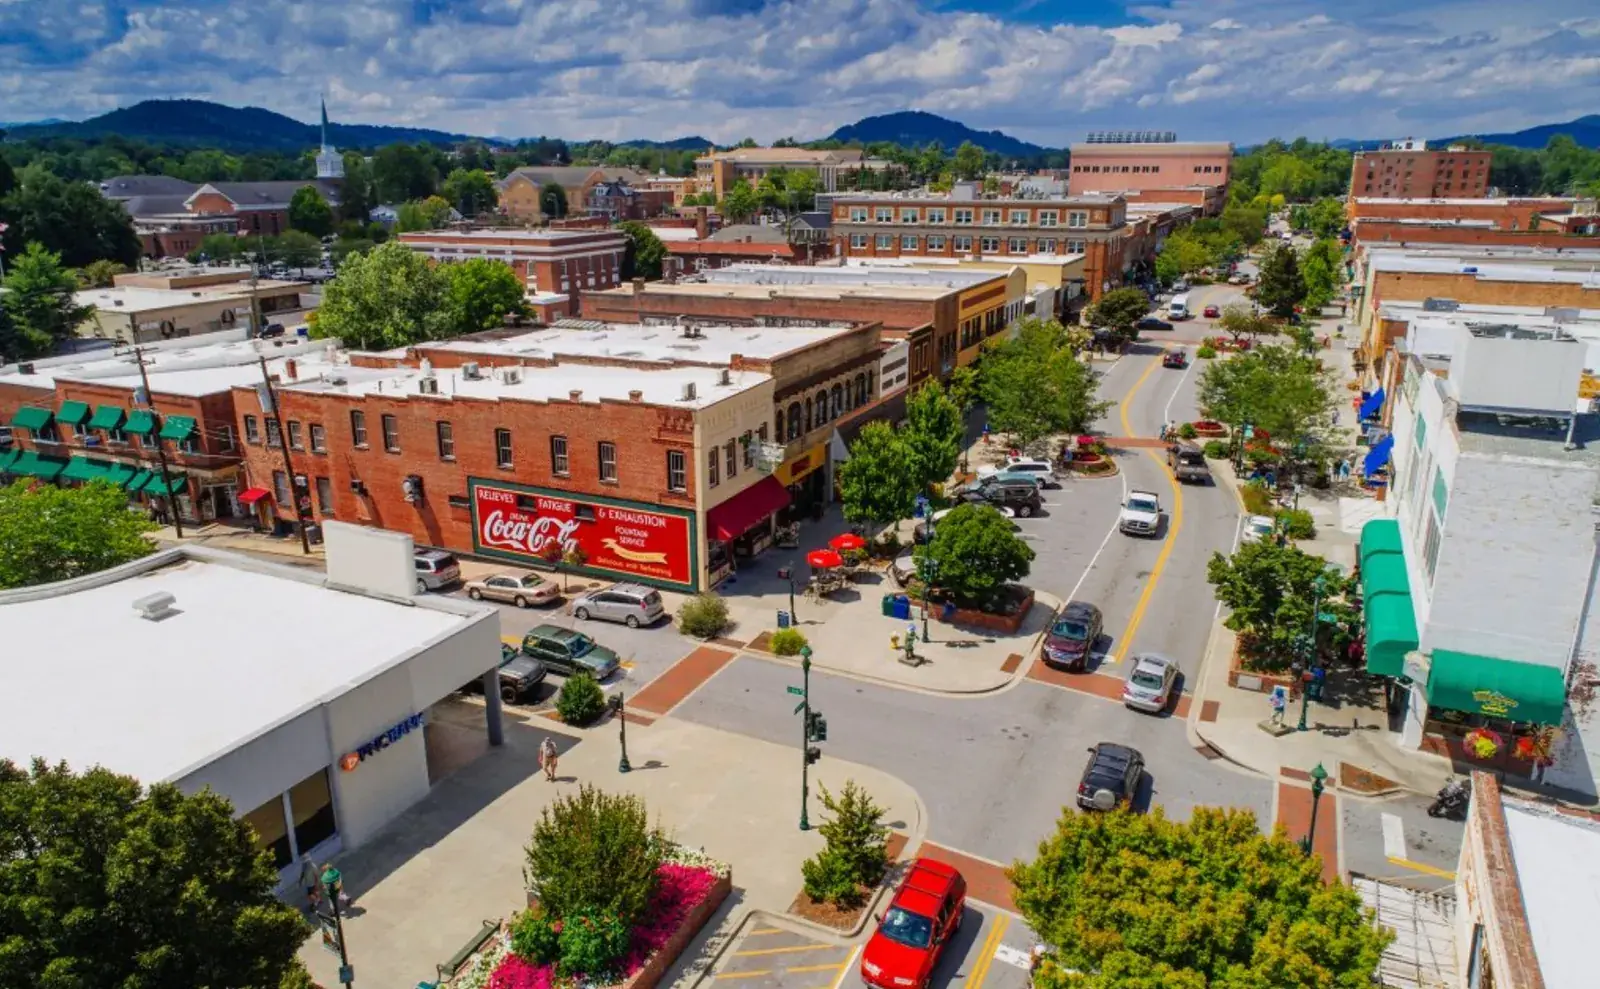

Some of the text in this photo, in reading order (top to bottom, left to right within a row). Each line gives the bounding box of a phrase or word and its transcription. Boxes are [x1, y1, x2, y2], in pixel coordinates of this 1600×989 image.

[478, 489, 667, 528] RELIEVES FATIGUE & EXHAUSTION
[614, 525, 649, 538] FOUNTAIN
[619, 536, 646, 547] SERVICE
